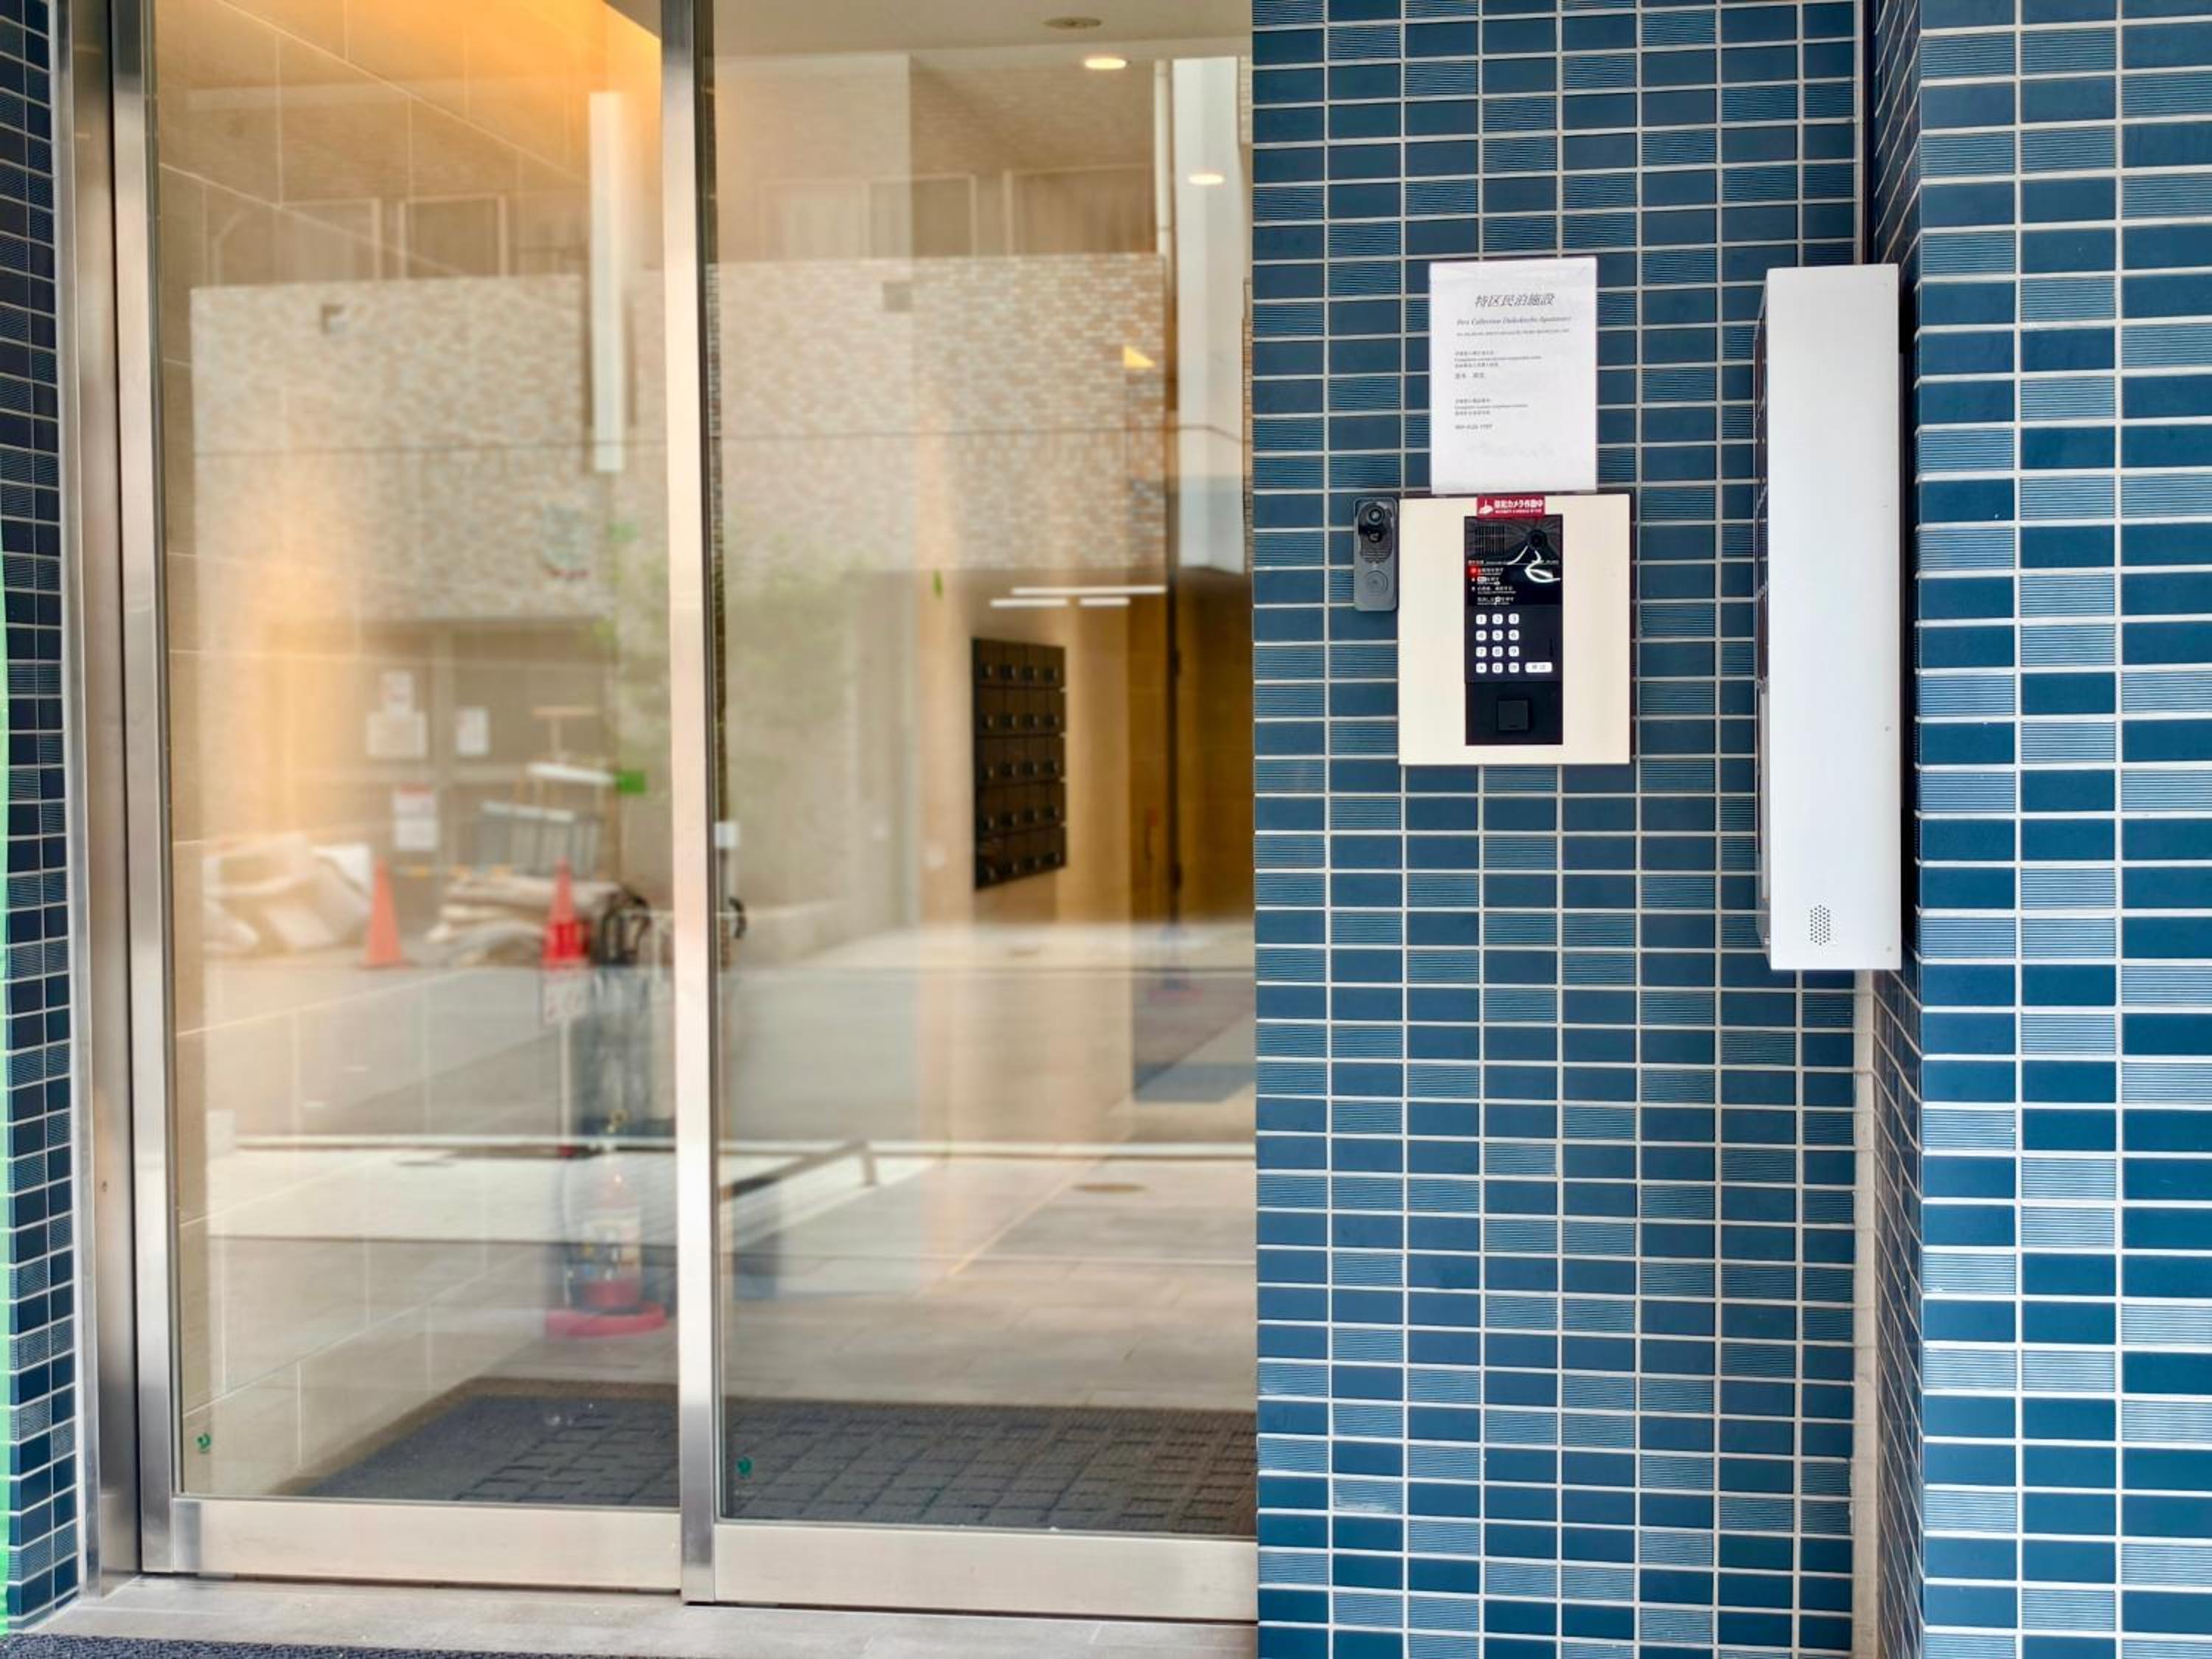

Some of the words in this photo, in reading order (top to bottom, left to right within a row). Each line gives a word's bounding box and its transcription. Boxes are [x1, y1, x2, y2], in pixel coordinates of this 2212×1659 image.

[1475, 293, 1556, 307] 特区民泊施設
